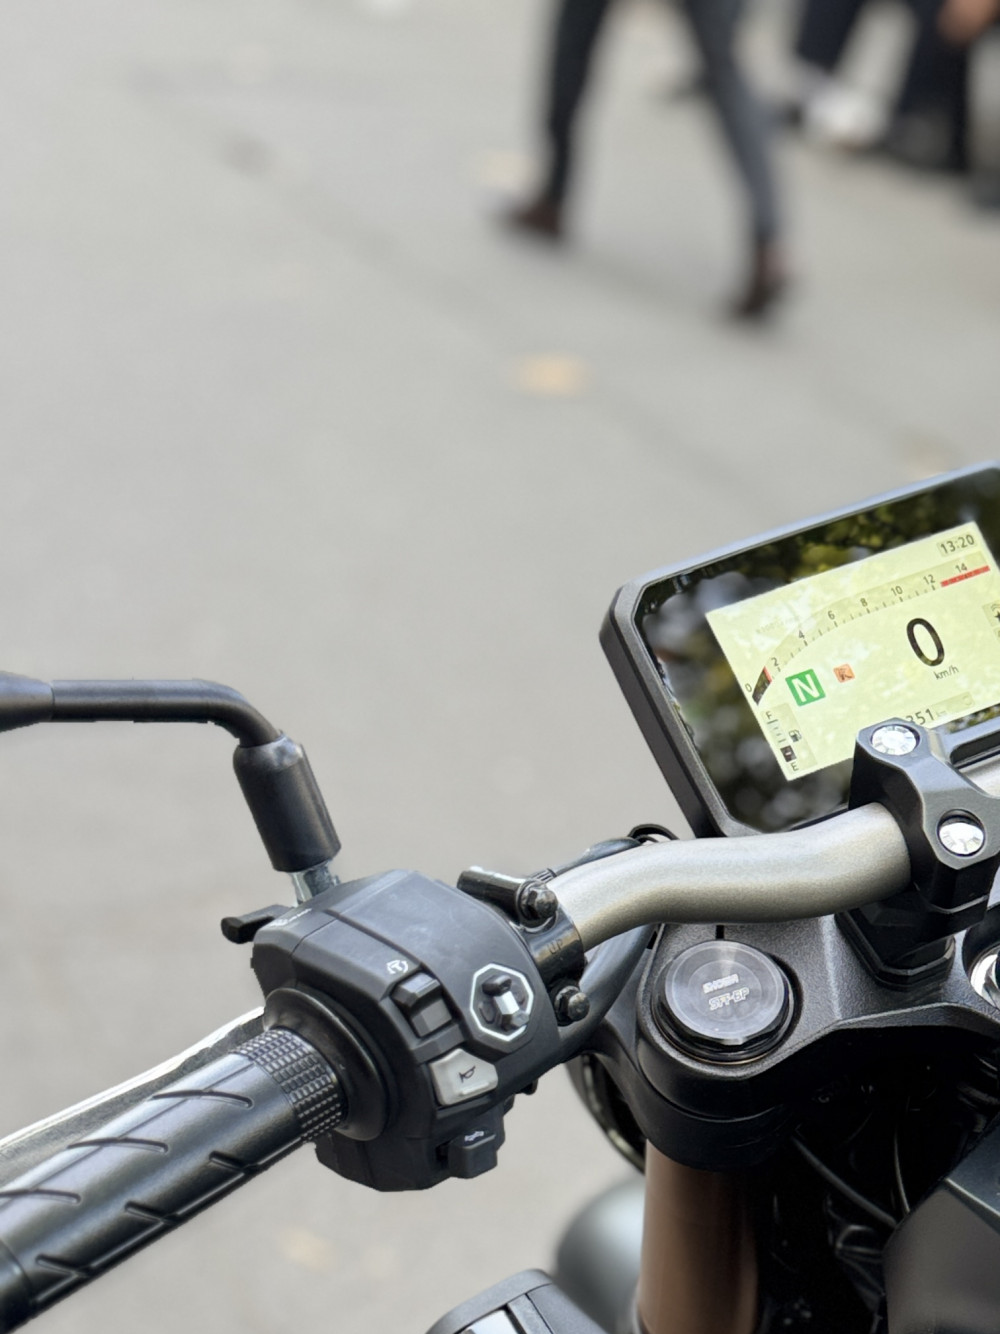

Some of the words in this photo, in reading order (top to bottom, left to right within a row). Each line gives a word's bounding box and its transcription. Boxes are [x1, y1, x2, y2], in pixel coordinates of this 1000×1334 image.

[940, 533, 975, 554] 13:20
[744, 683, 752, 692] 0
[771, 656, 779, 667] 2
[799, 629, 805, 639] 4
[828, 610, 836, 620] 6
[860, 597, 868, 607] 8
[890, 585, 903, 597] 10
[923, 574, 936, 585] 12
[955, 562, 968, 574] 14
[906, 618, 945, 667] 0
[933, 664, 960, 680] km/h
[792, 673, 820, 703] N
